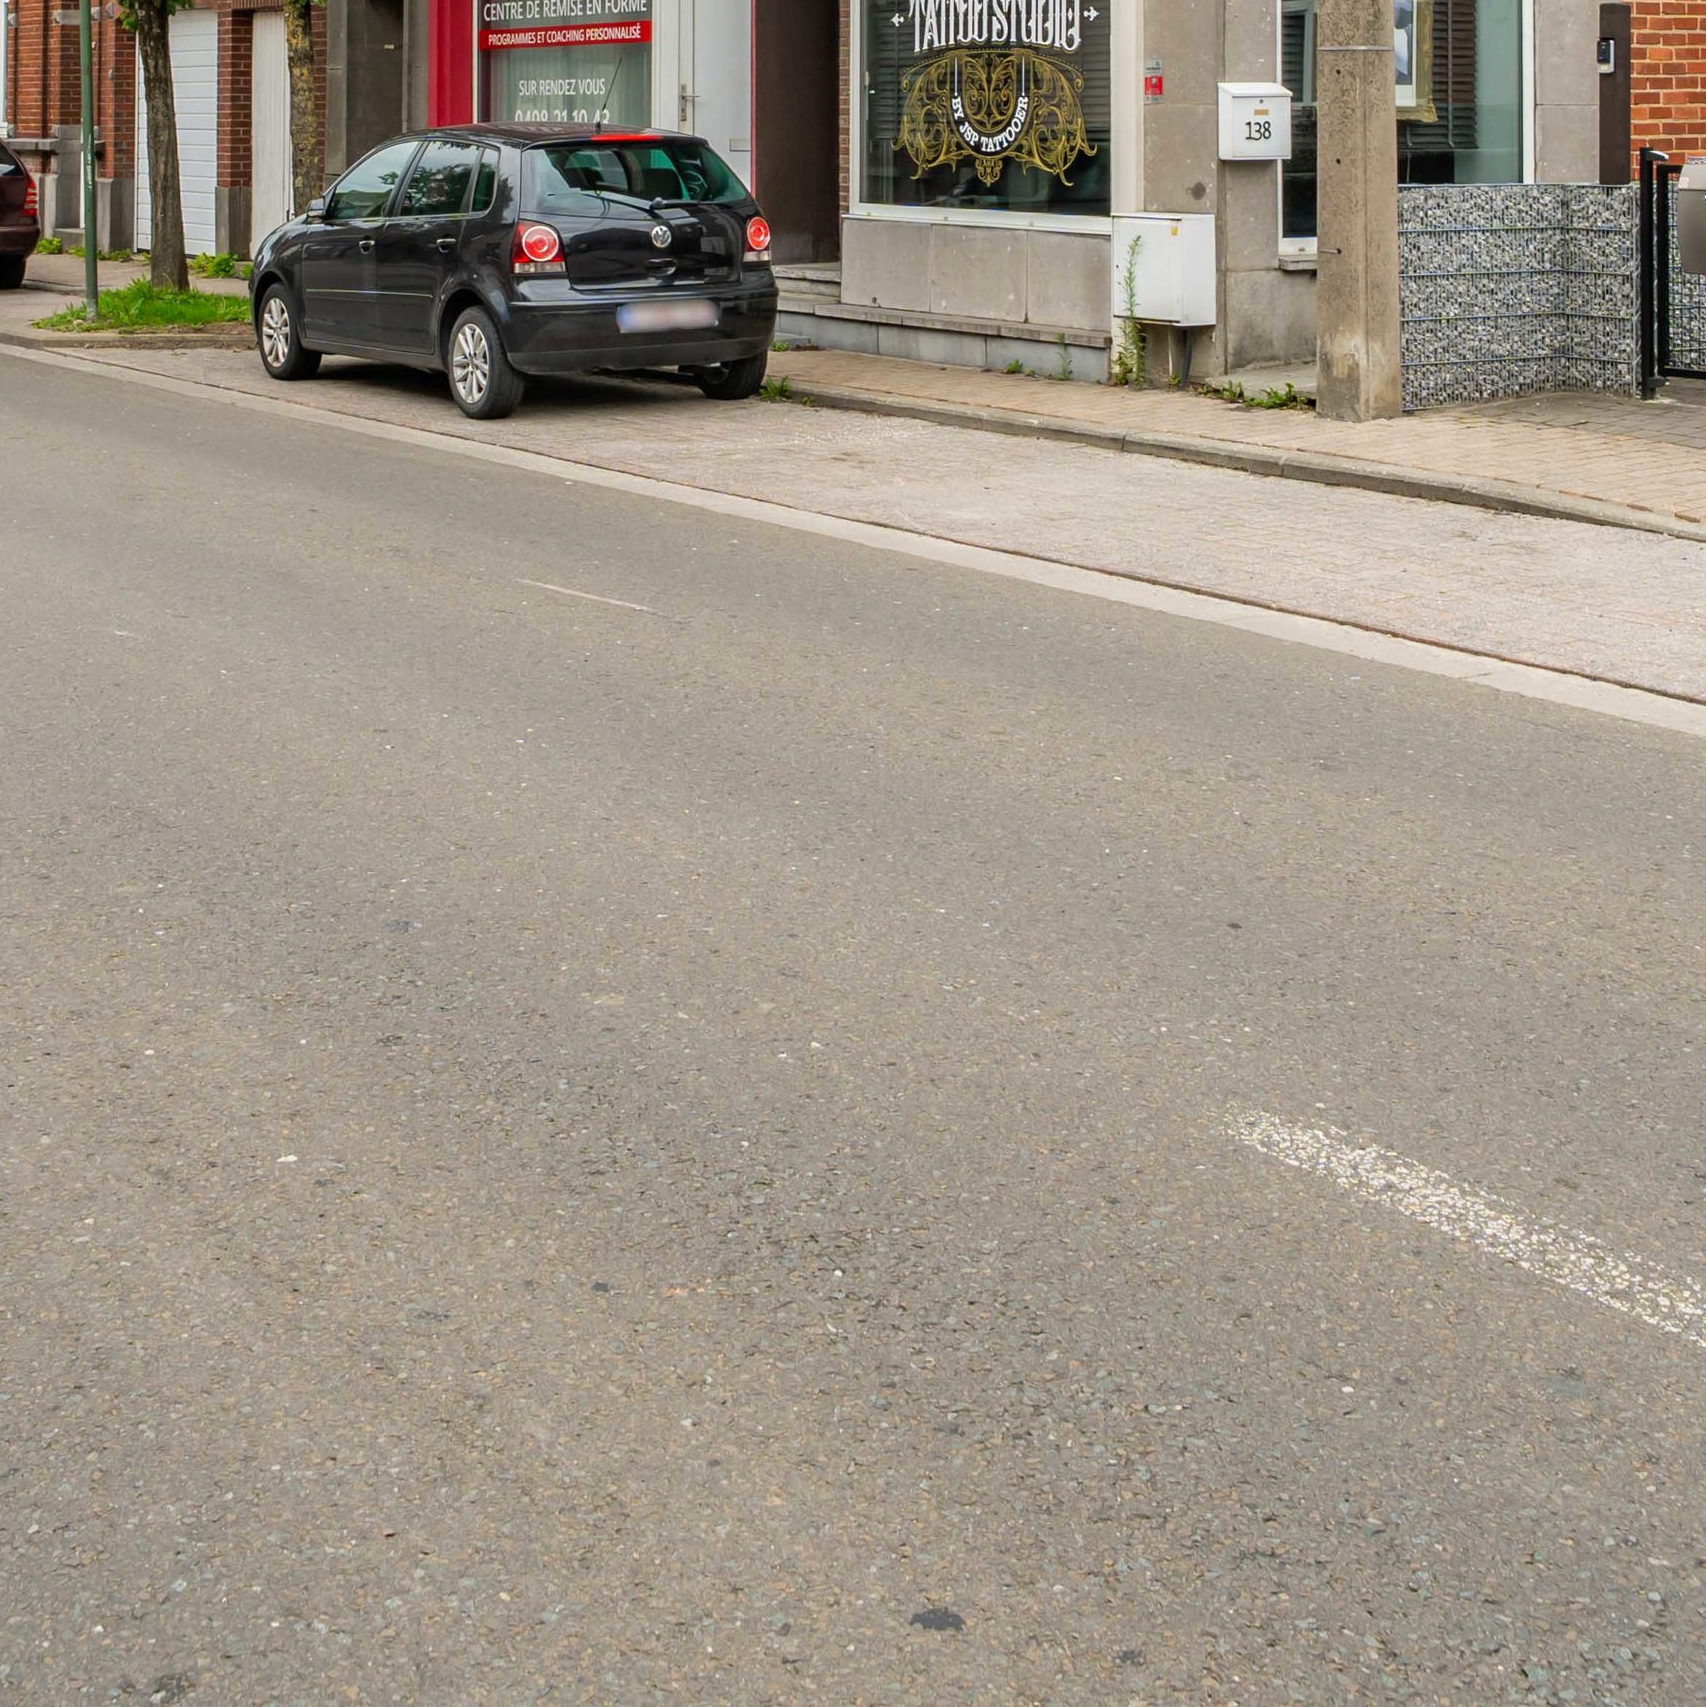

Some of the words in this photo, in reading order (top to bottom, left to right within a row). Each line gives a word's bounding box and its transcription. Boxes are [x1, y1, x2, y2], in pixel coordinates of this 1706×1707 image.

[484, 1, 523, 21] CENTRE
[527, 0, 540, 18] DE
[488, 33, 536, 45] PROGRAMMES
[537, 32, 545, 43] ET
[547, 30, 584, 43] COACHING
[586, 23, 641, 41] PERSONNALISÉ
[519, 80, 538, 96] SUR
[540, 79, 576, 95] RENDEZ
[578, 78, 605, 95] VOUS
[952, 96, 965, 120] BY
[959, 122, 979, 146] JSP
[980, 96, 1028, 152] TATTOOER
[1245, 121, 1272, 141] 138
